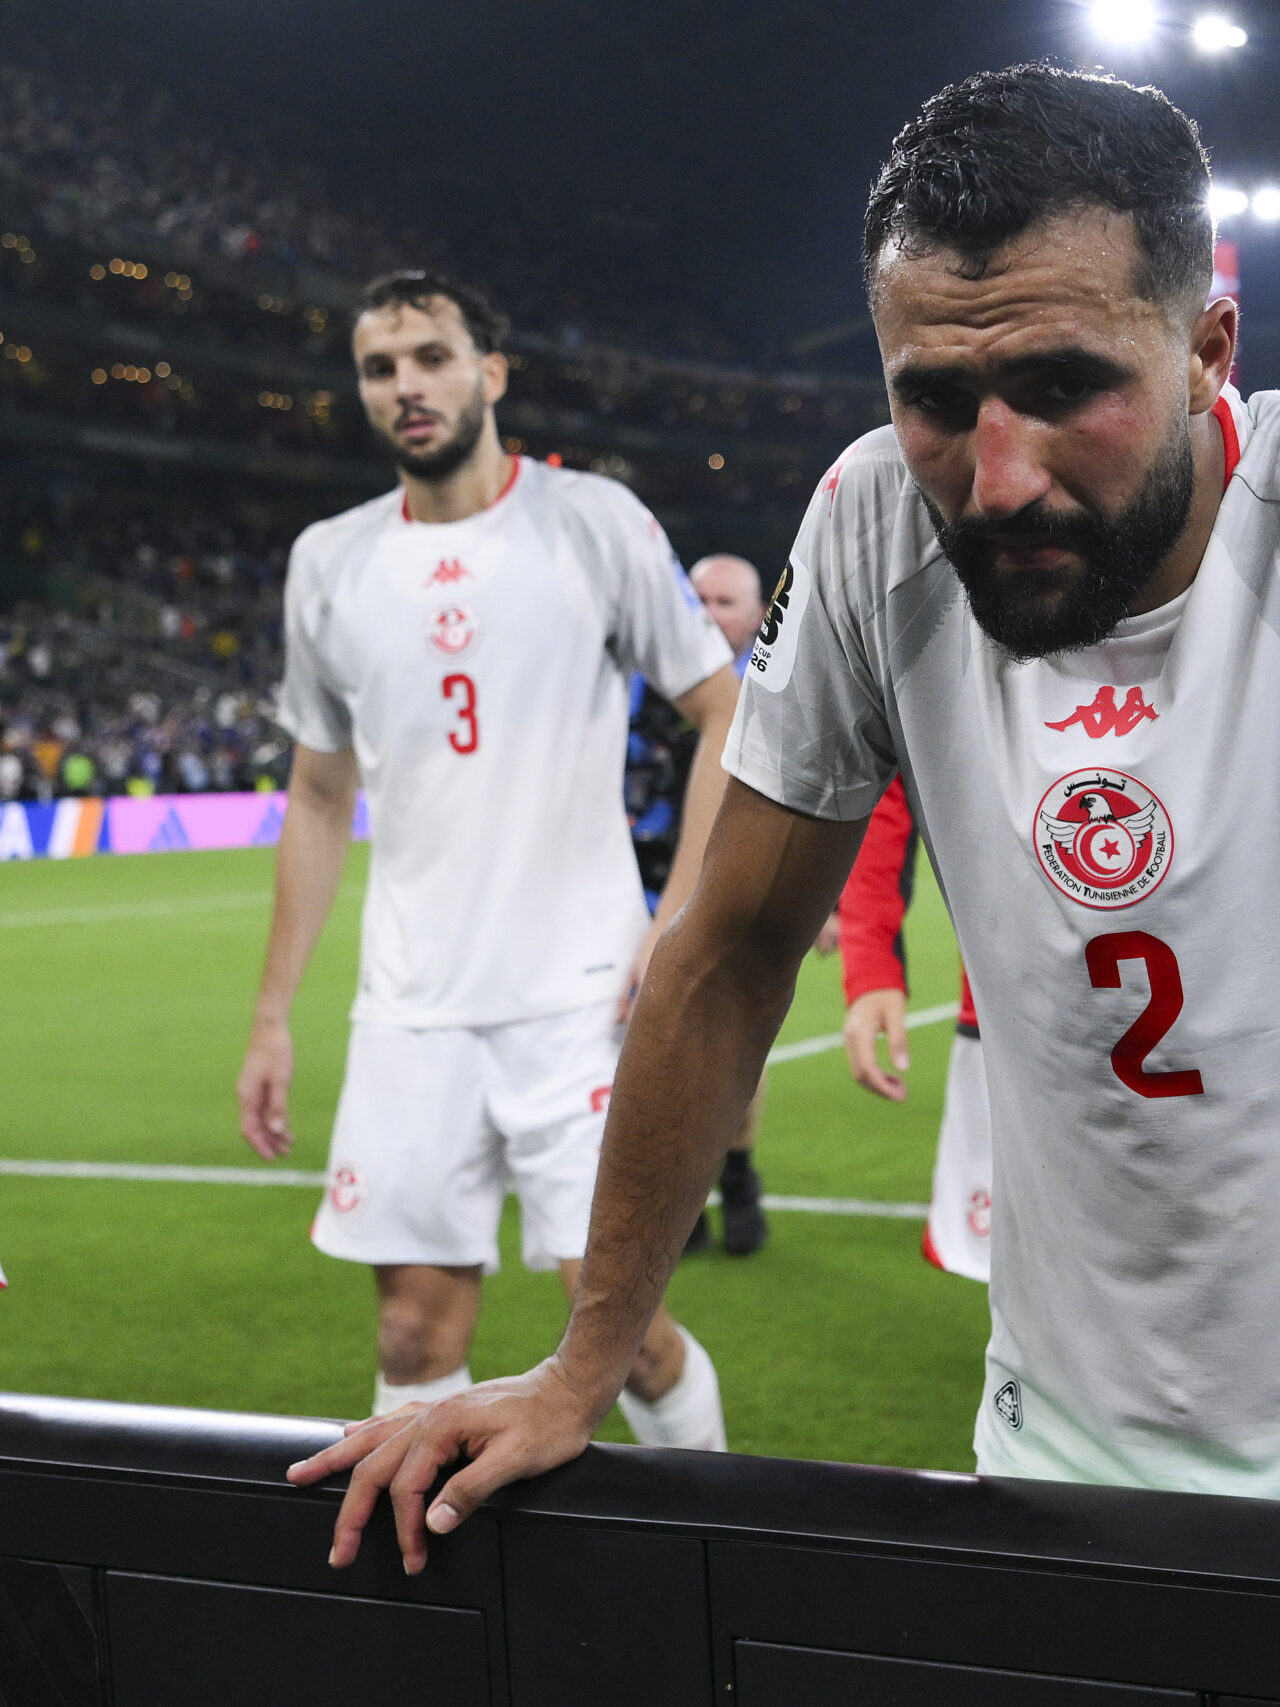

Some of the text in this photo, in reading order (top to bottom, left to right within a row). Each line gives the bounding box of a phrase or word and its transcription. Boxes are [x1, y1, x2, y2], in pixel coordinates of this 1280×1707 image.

[759, 647, 771, 659] CUP
[442, 673, 477, 754] 3
[1043, 830, 1166, 901] FEDERATION TUNISIENNE DE FOOTBALL
[1085, 930, 1204, 1098] 2
